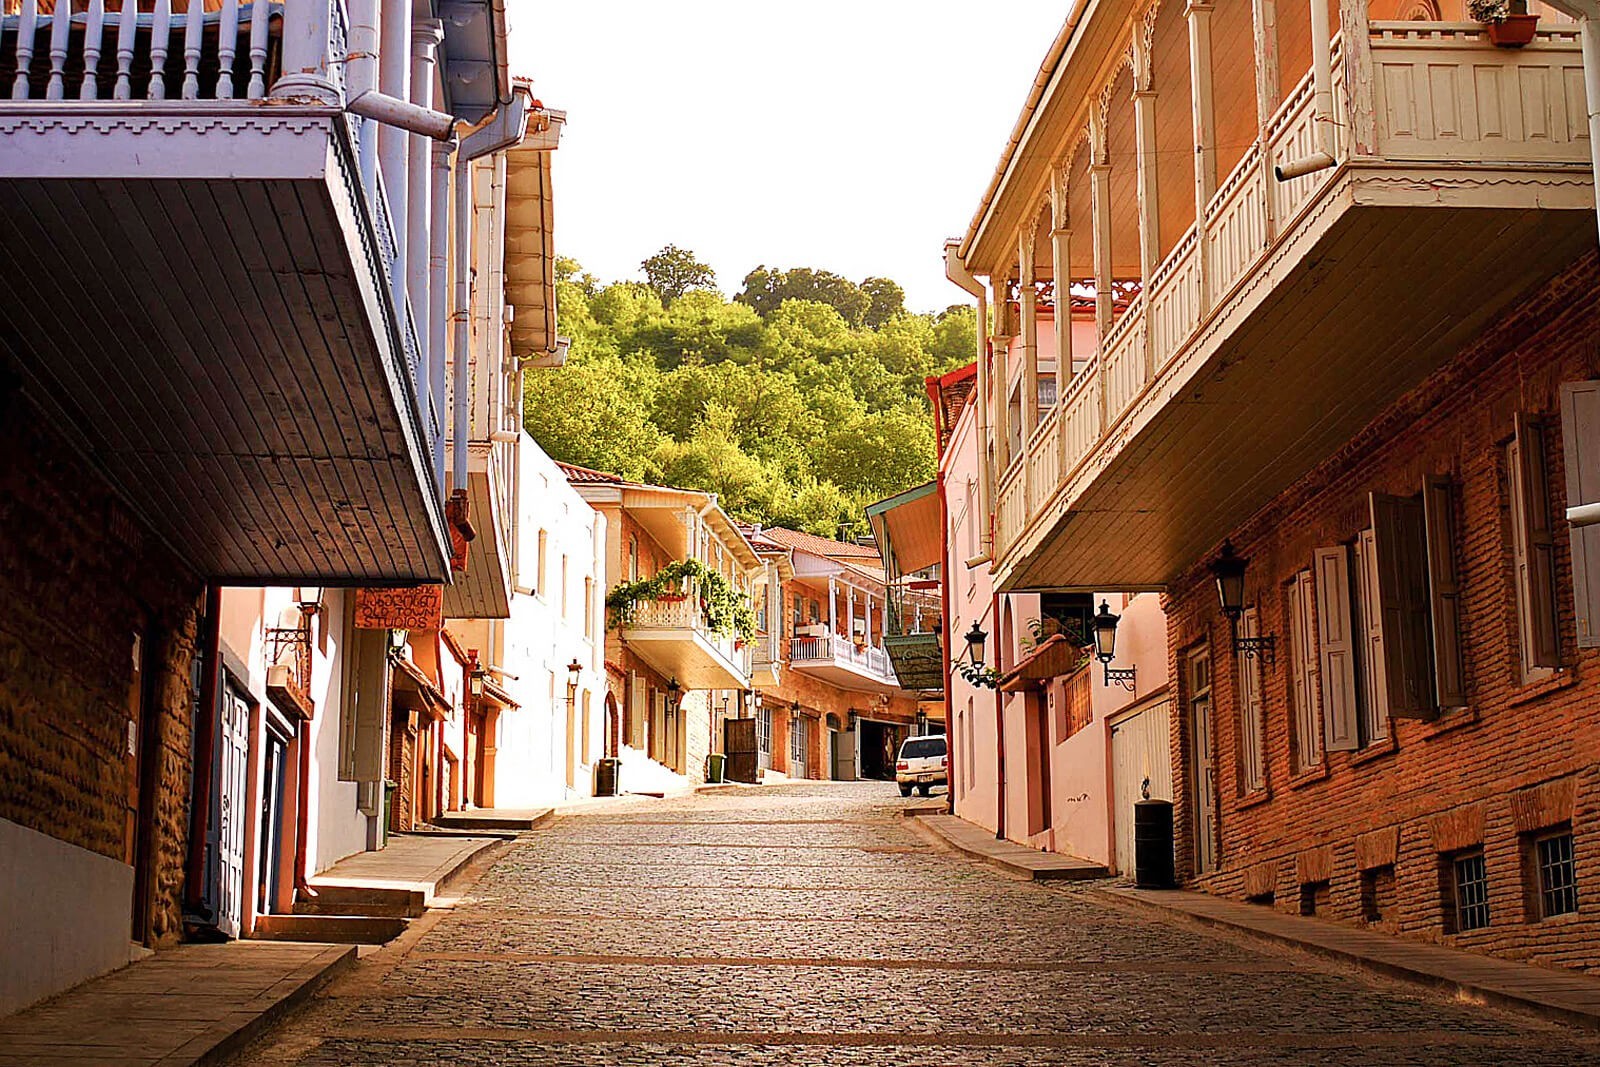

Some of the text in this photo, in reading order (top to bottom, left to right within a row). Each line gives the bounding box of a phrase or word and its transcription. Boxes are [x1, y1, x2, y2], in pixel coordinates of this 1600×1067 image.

[362, 607, 434, 617] OLD TOWN
[364, 616, 428, 628] STUDIOS
